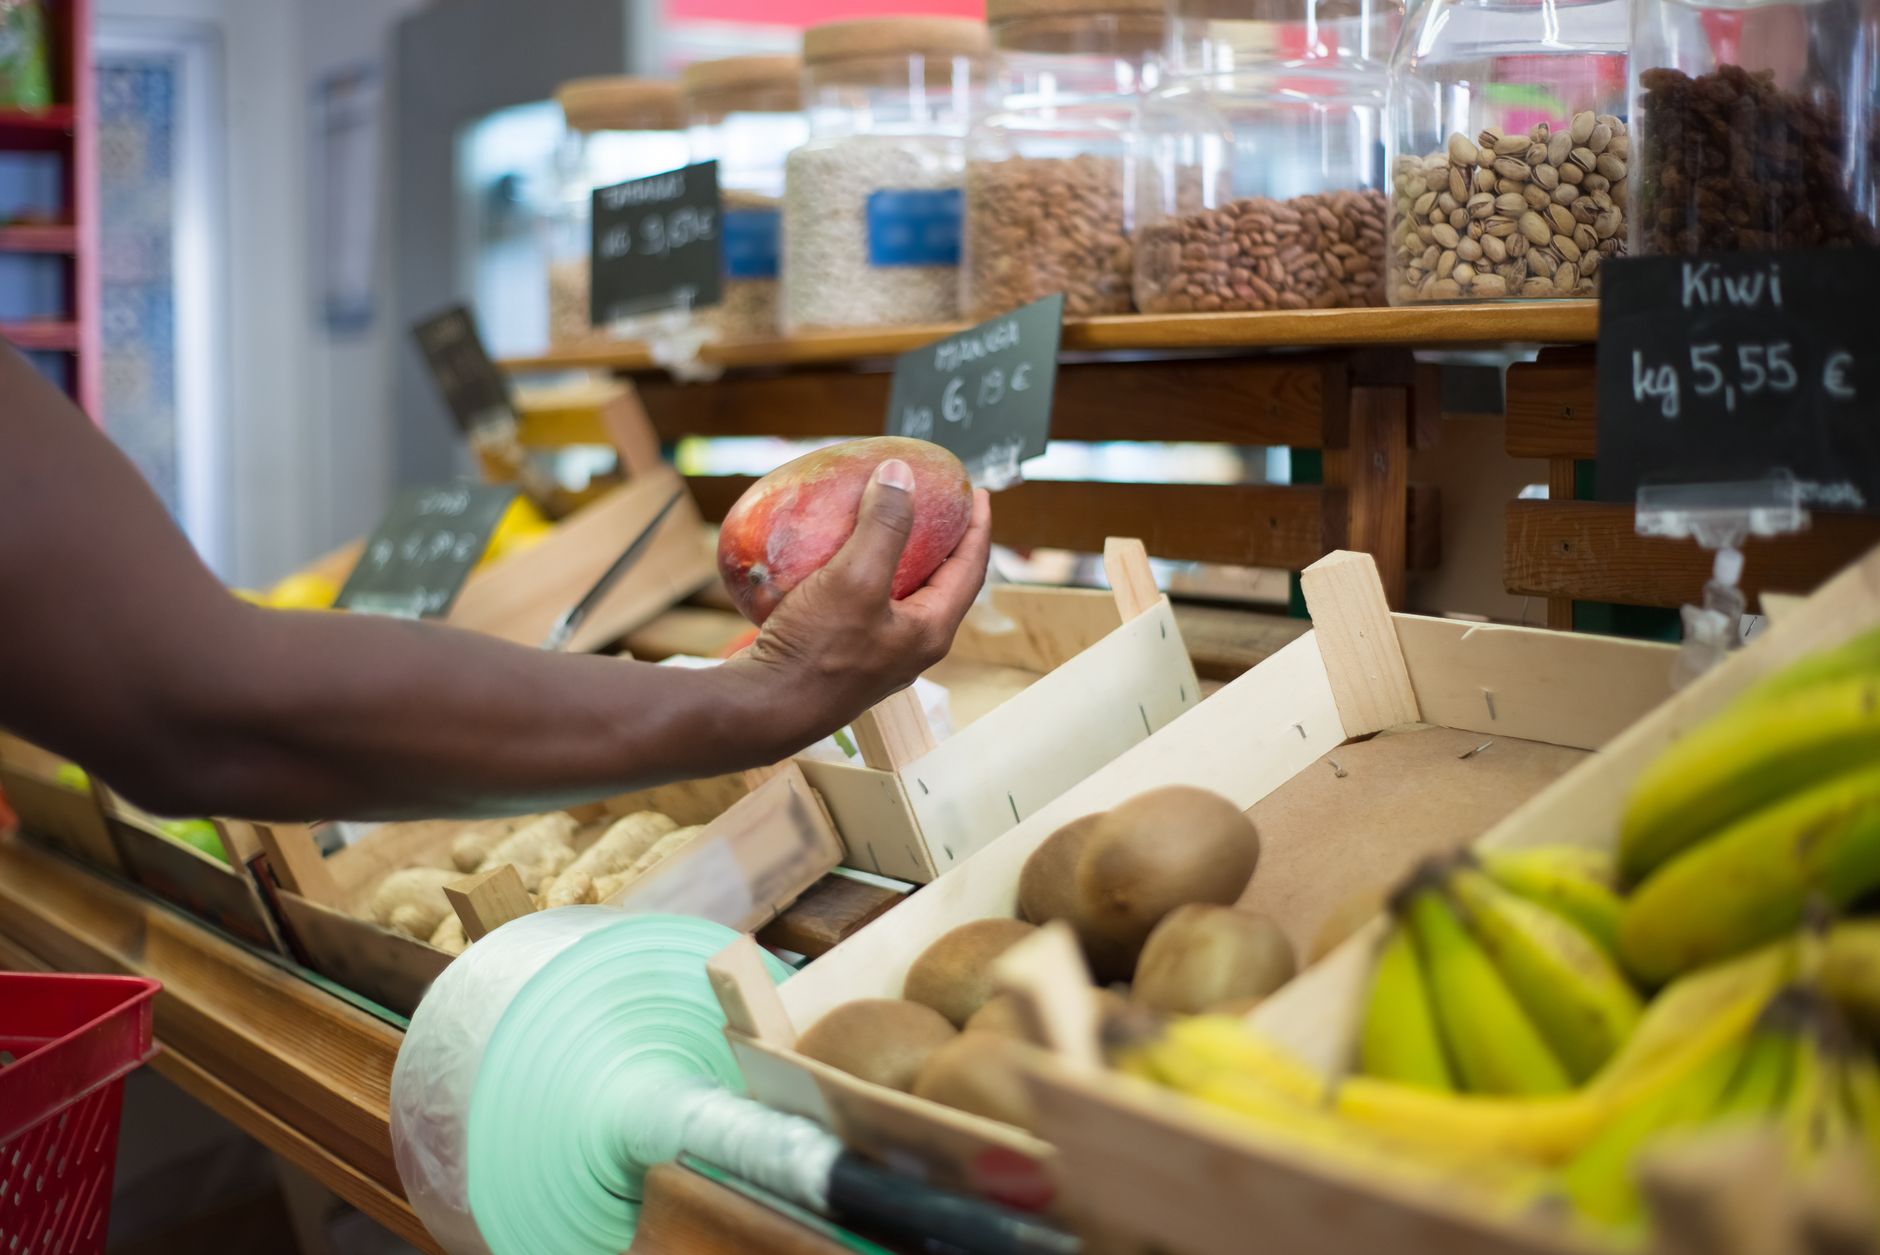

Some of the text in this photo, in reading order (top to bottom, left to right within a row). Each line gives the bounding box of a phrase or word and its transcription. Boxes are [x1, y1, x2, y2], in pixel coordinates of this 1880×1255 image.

[1682, 262, 1782, 308] Kiwi
[1632, 343, 1856, 418] kg 5,55 €
